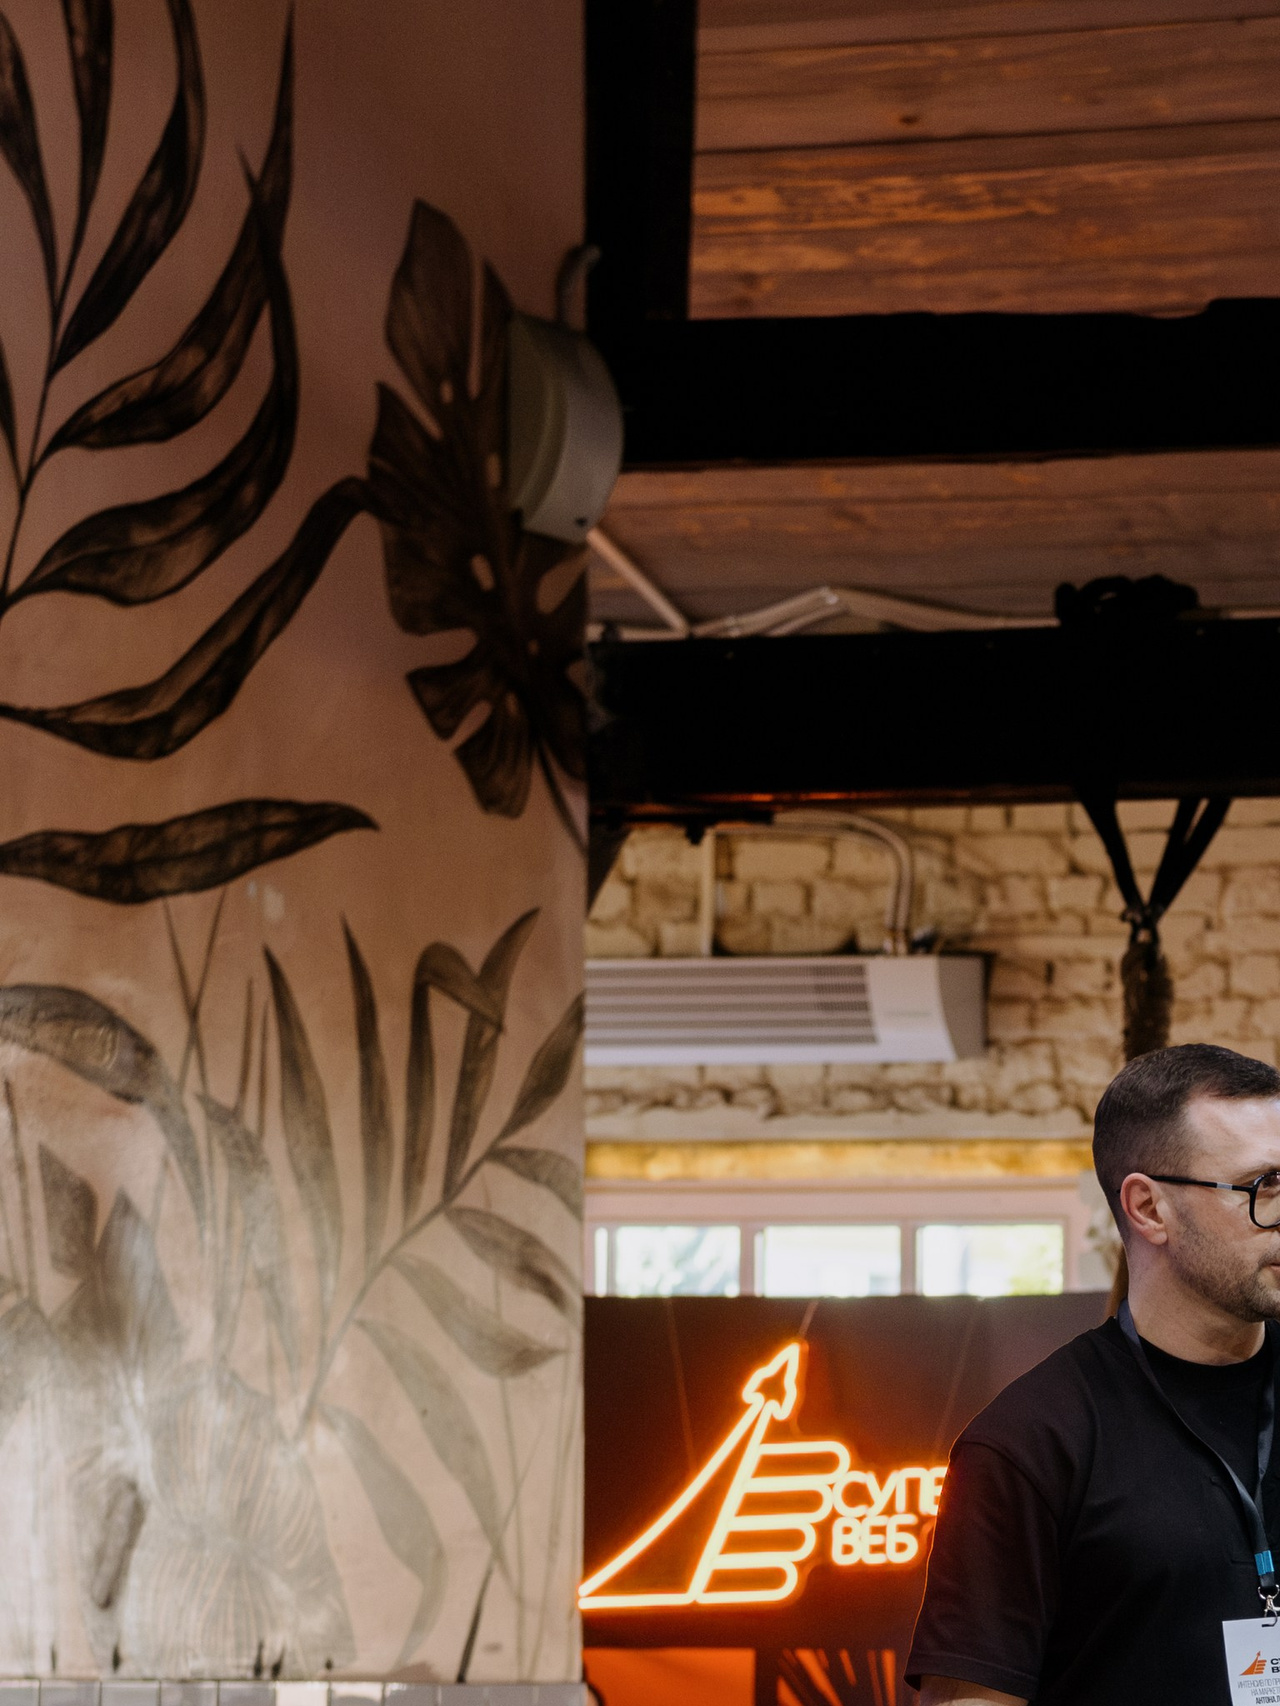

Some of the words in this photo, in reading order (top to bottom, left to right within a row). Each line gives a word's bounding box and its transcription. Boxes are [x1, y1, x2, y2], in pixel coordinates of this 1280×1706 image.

[833, 1467, 949, 1518] СУПЕ
[832, 1513, 918, 1565] ВЕБ
[1255, 1696, 1276, 1705] АНТОНА
